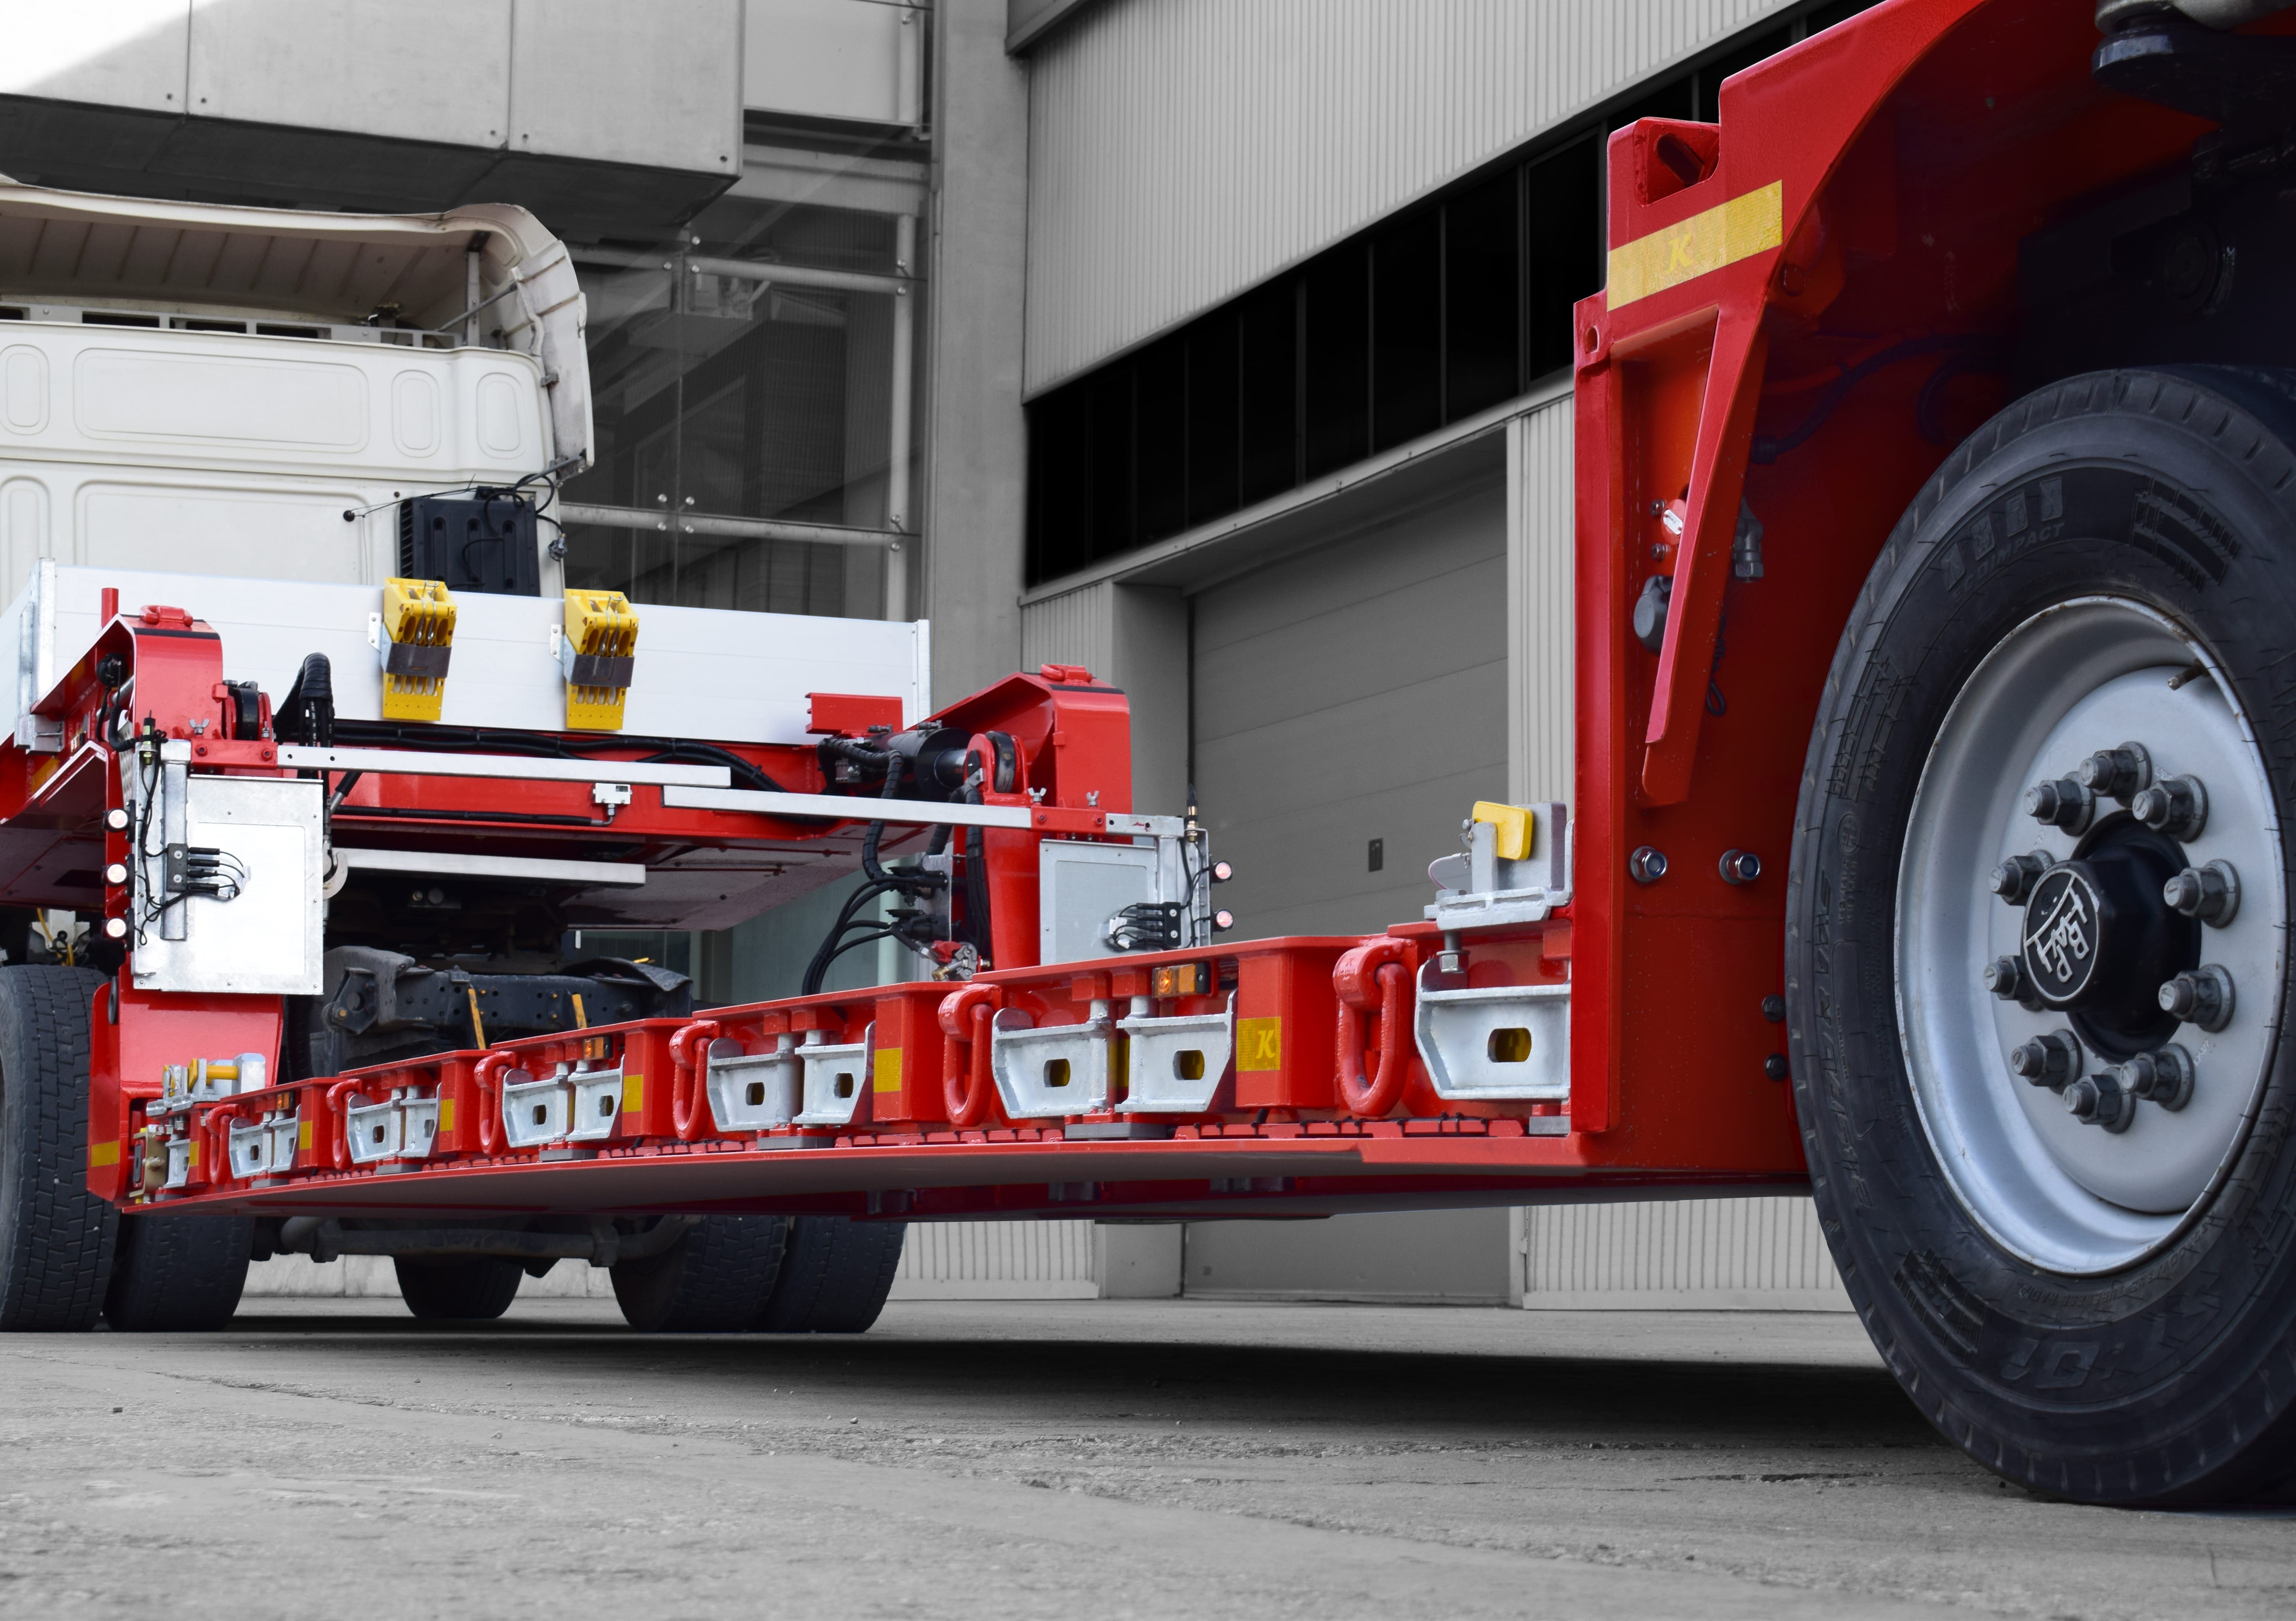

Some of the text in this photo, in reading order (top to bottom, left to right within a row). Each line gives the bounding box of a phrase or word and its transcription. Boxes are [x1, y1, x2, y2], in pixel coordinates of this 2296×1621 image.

[1667, 232, 1694, 274] K
[2033, 885, 2091, 984] BPW
[1256, 1029, 1276, 1059] K
